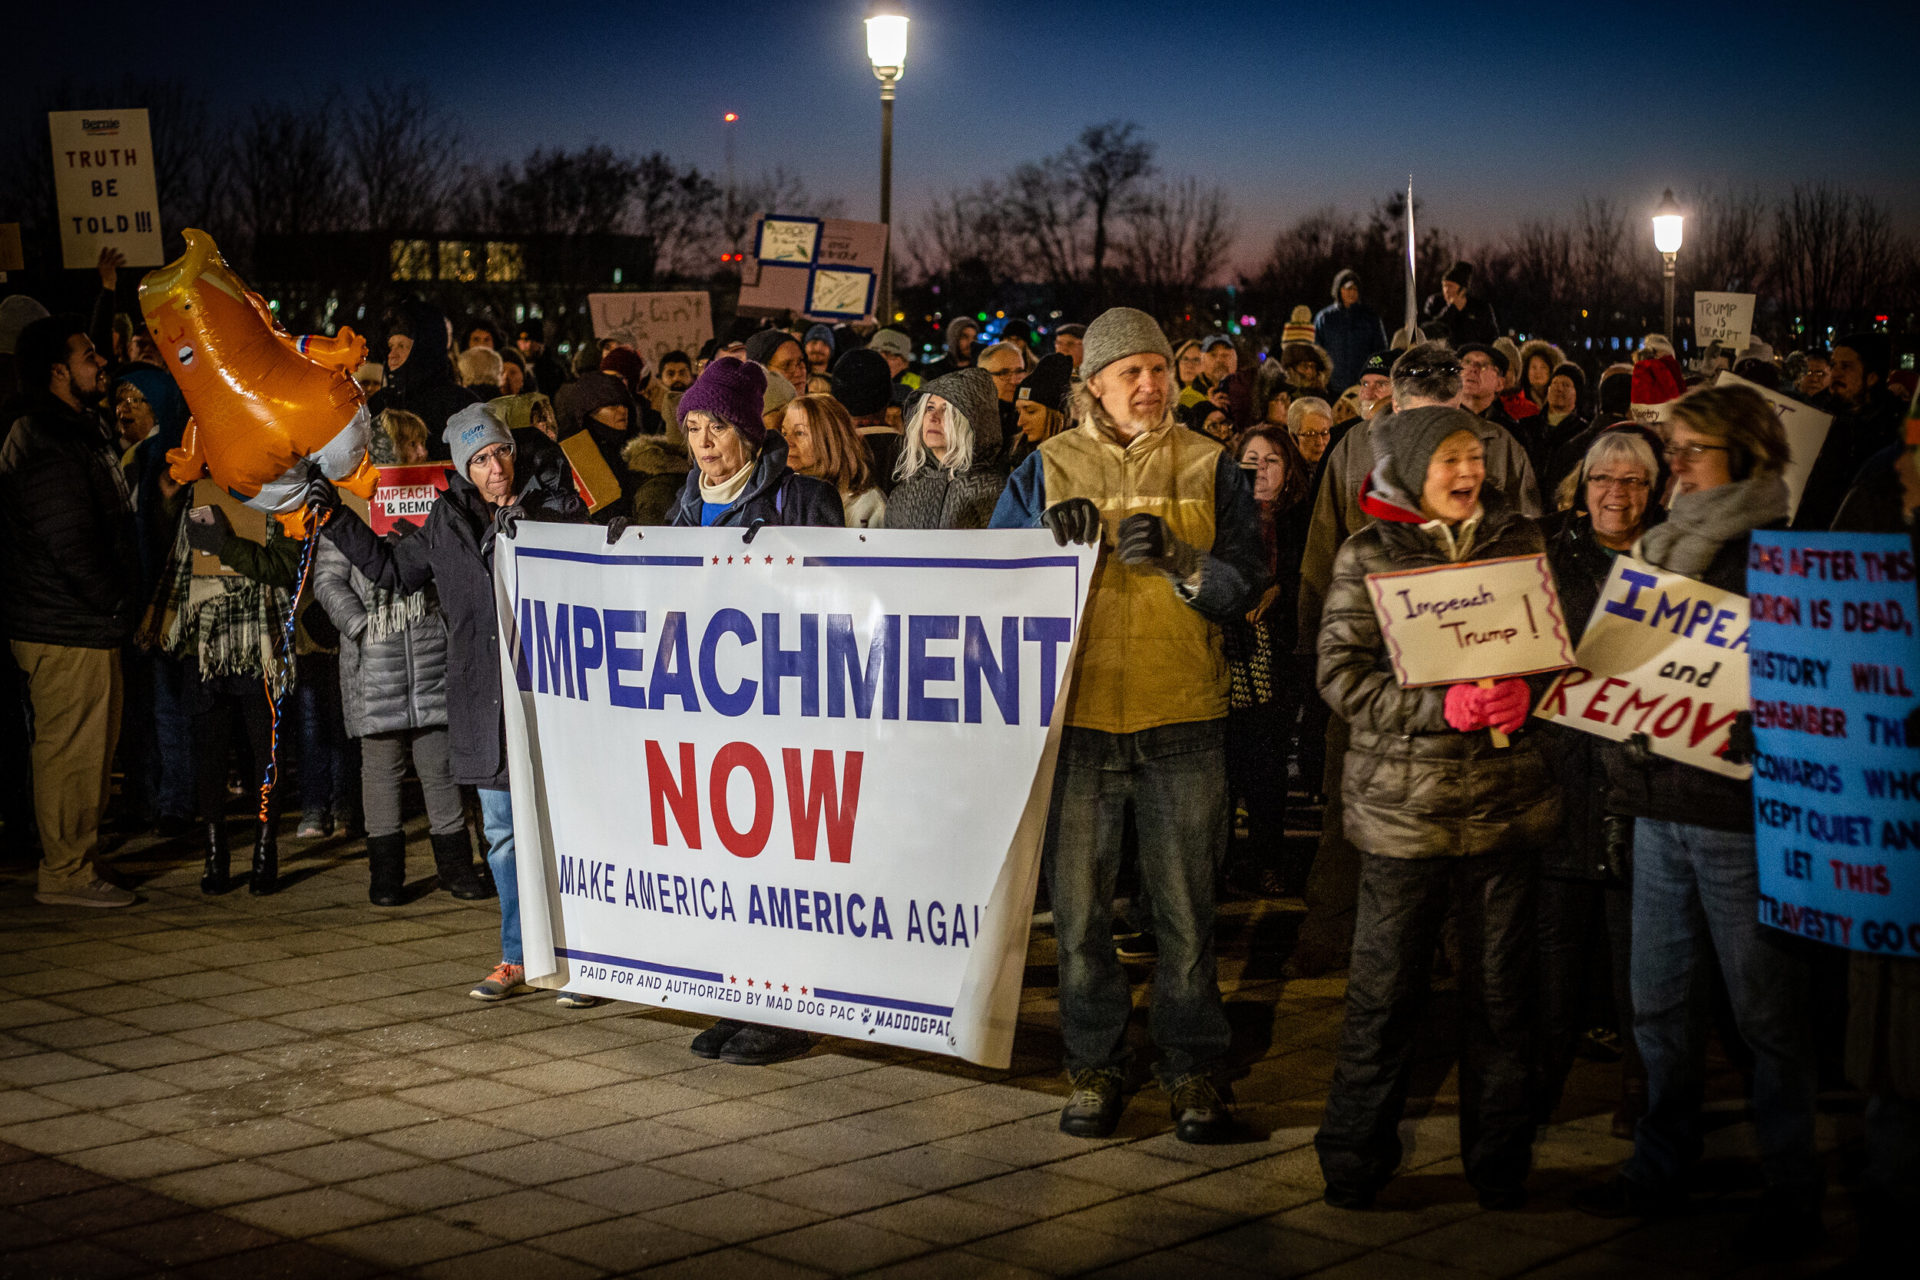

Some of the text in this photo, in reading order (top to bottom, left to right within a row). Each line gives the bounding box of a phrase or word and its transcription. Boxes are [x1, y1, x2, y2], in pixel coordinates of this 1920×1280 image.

[82, 119, 120, 130] Bernie
[65, 148, 137, 168] TRUTH
[91, 179, 118, 197] BE
[1697, 299, 1738, 317] TRUMP
[1716, 316, 1727, 328] IS
[376, 486, 433, 501] IMPEACH
[386, 502, 397, 514] &
[1789, 548, 1858, 581] AFTER
[1861, 550, 1916, 582] THIS
[1396, 584, 1496, 620] Impeach
[1810, 599, 1832, 629] IS
[516, 598, 1071, 727] IMPEACHMENT
[1658, 661, 1721, 688] and
[1751, 651, 1914, 697] HISTORY WILL
[1542, 667, 1738, 757] REMOV
[1753, 750, 1843, 794] COWARDS
[644, 740, 864, 864] NOW
[1758, 798, 1802, 833] KEPT
[1807, 809, 1872, 846] QUIET
[1785, 848, 1891, 896] LET THIS
[559, 854, 984, 948] MAKE AMERICA AMERICA AGAI
[1758, 893, 1853, 945] TRAVESTY
[580, 964, 607, 981] PAID
[611, 969, 634, 986] FOR
[636, 973, 661, 991] AND
[665, 978, 742, 1003] AUTHORIZED
[746, 991, 762, 1006] BY
[766, 994, 793, 1011] MAD
[797, 999, 825, 1016] DOG
[830, 1005, 856, 1021] PAC
